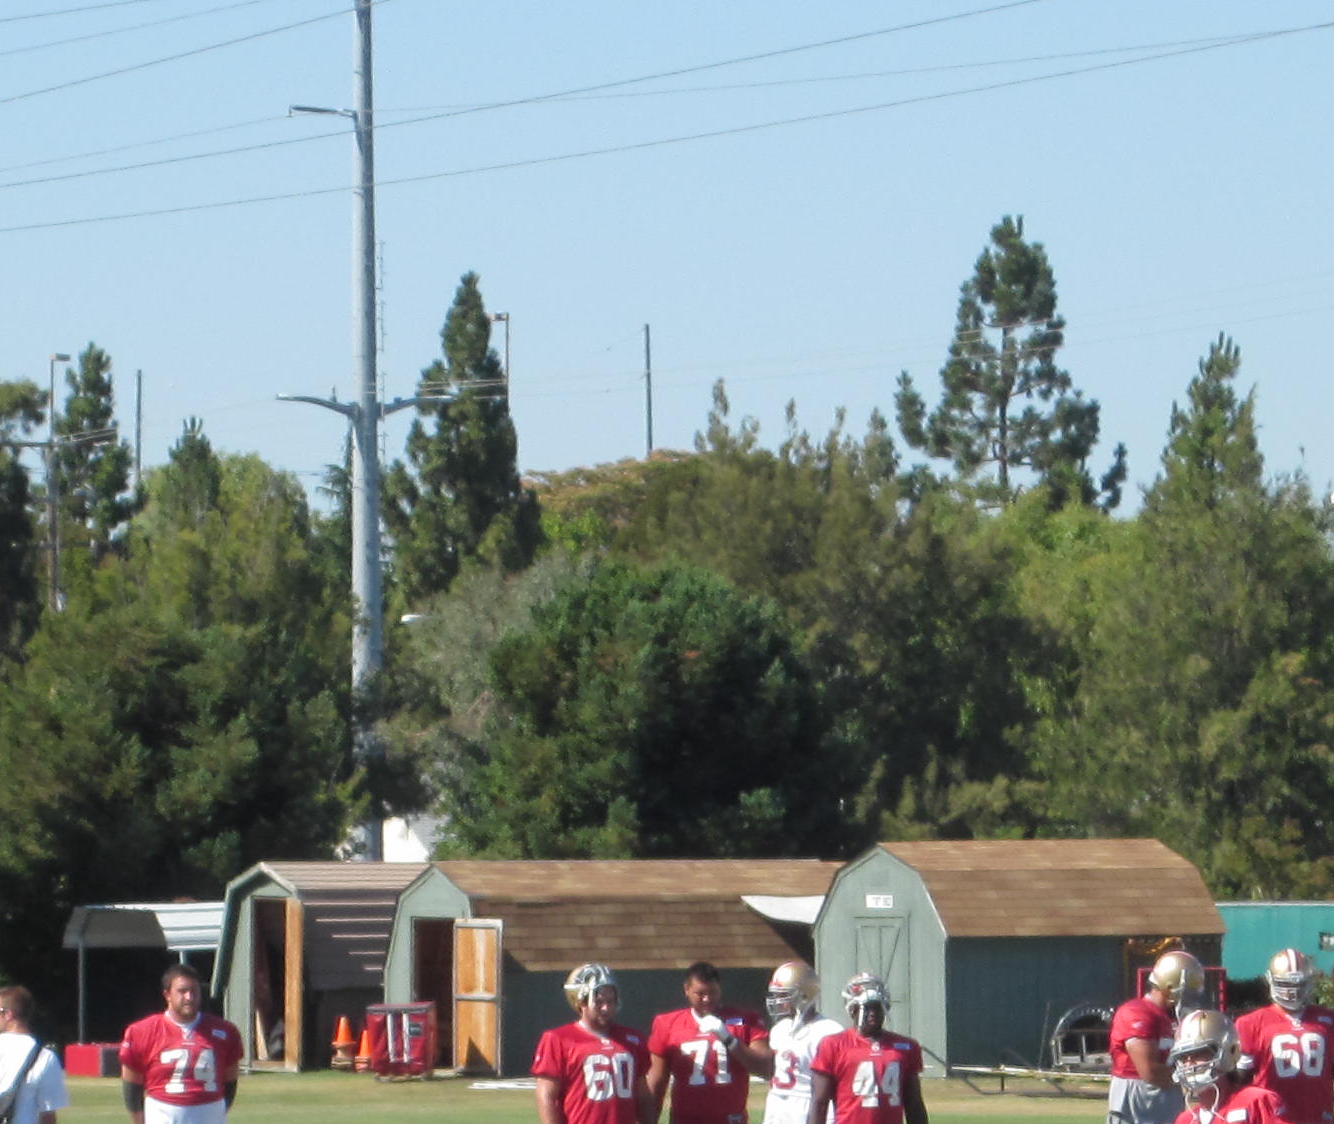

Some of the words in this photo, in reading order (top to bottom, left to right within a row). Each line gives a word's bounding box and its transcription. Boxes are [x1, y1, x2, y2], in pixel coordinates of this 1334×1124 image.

[160, 1048, 217, 1094] 74
[582, 1052, 635, 1102] 60
[680, 1040, 732, 1086] 71
[769, 1049, 799, 1090] 3
[1271, 1032, 1326, 1078] 68
[852, 1060, 901, 1108] 44
